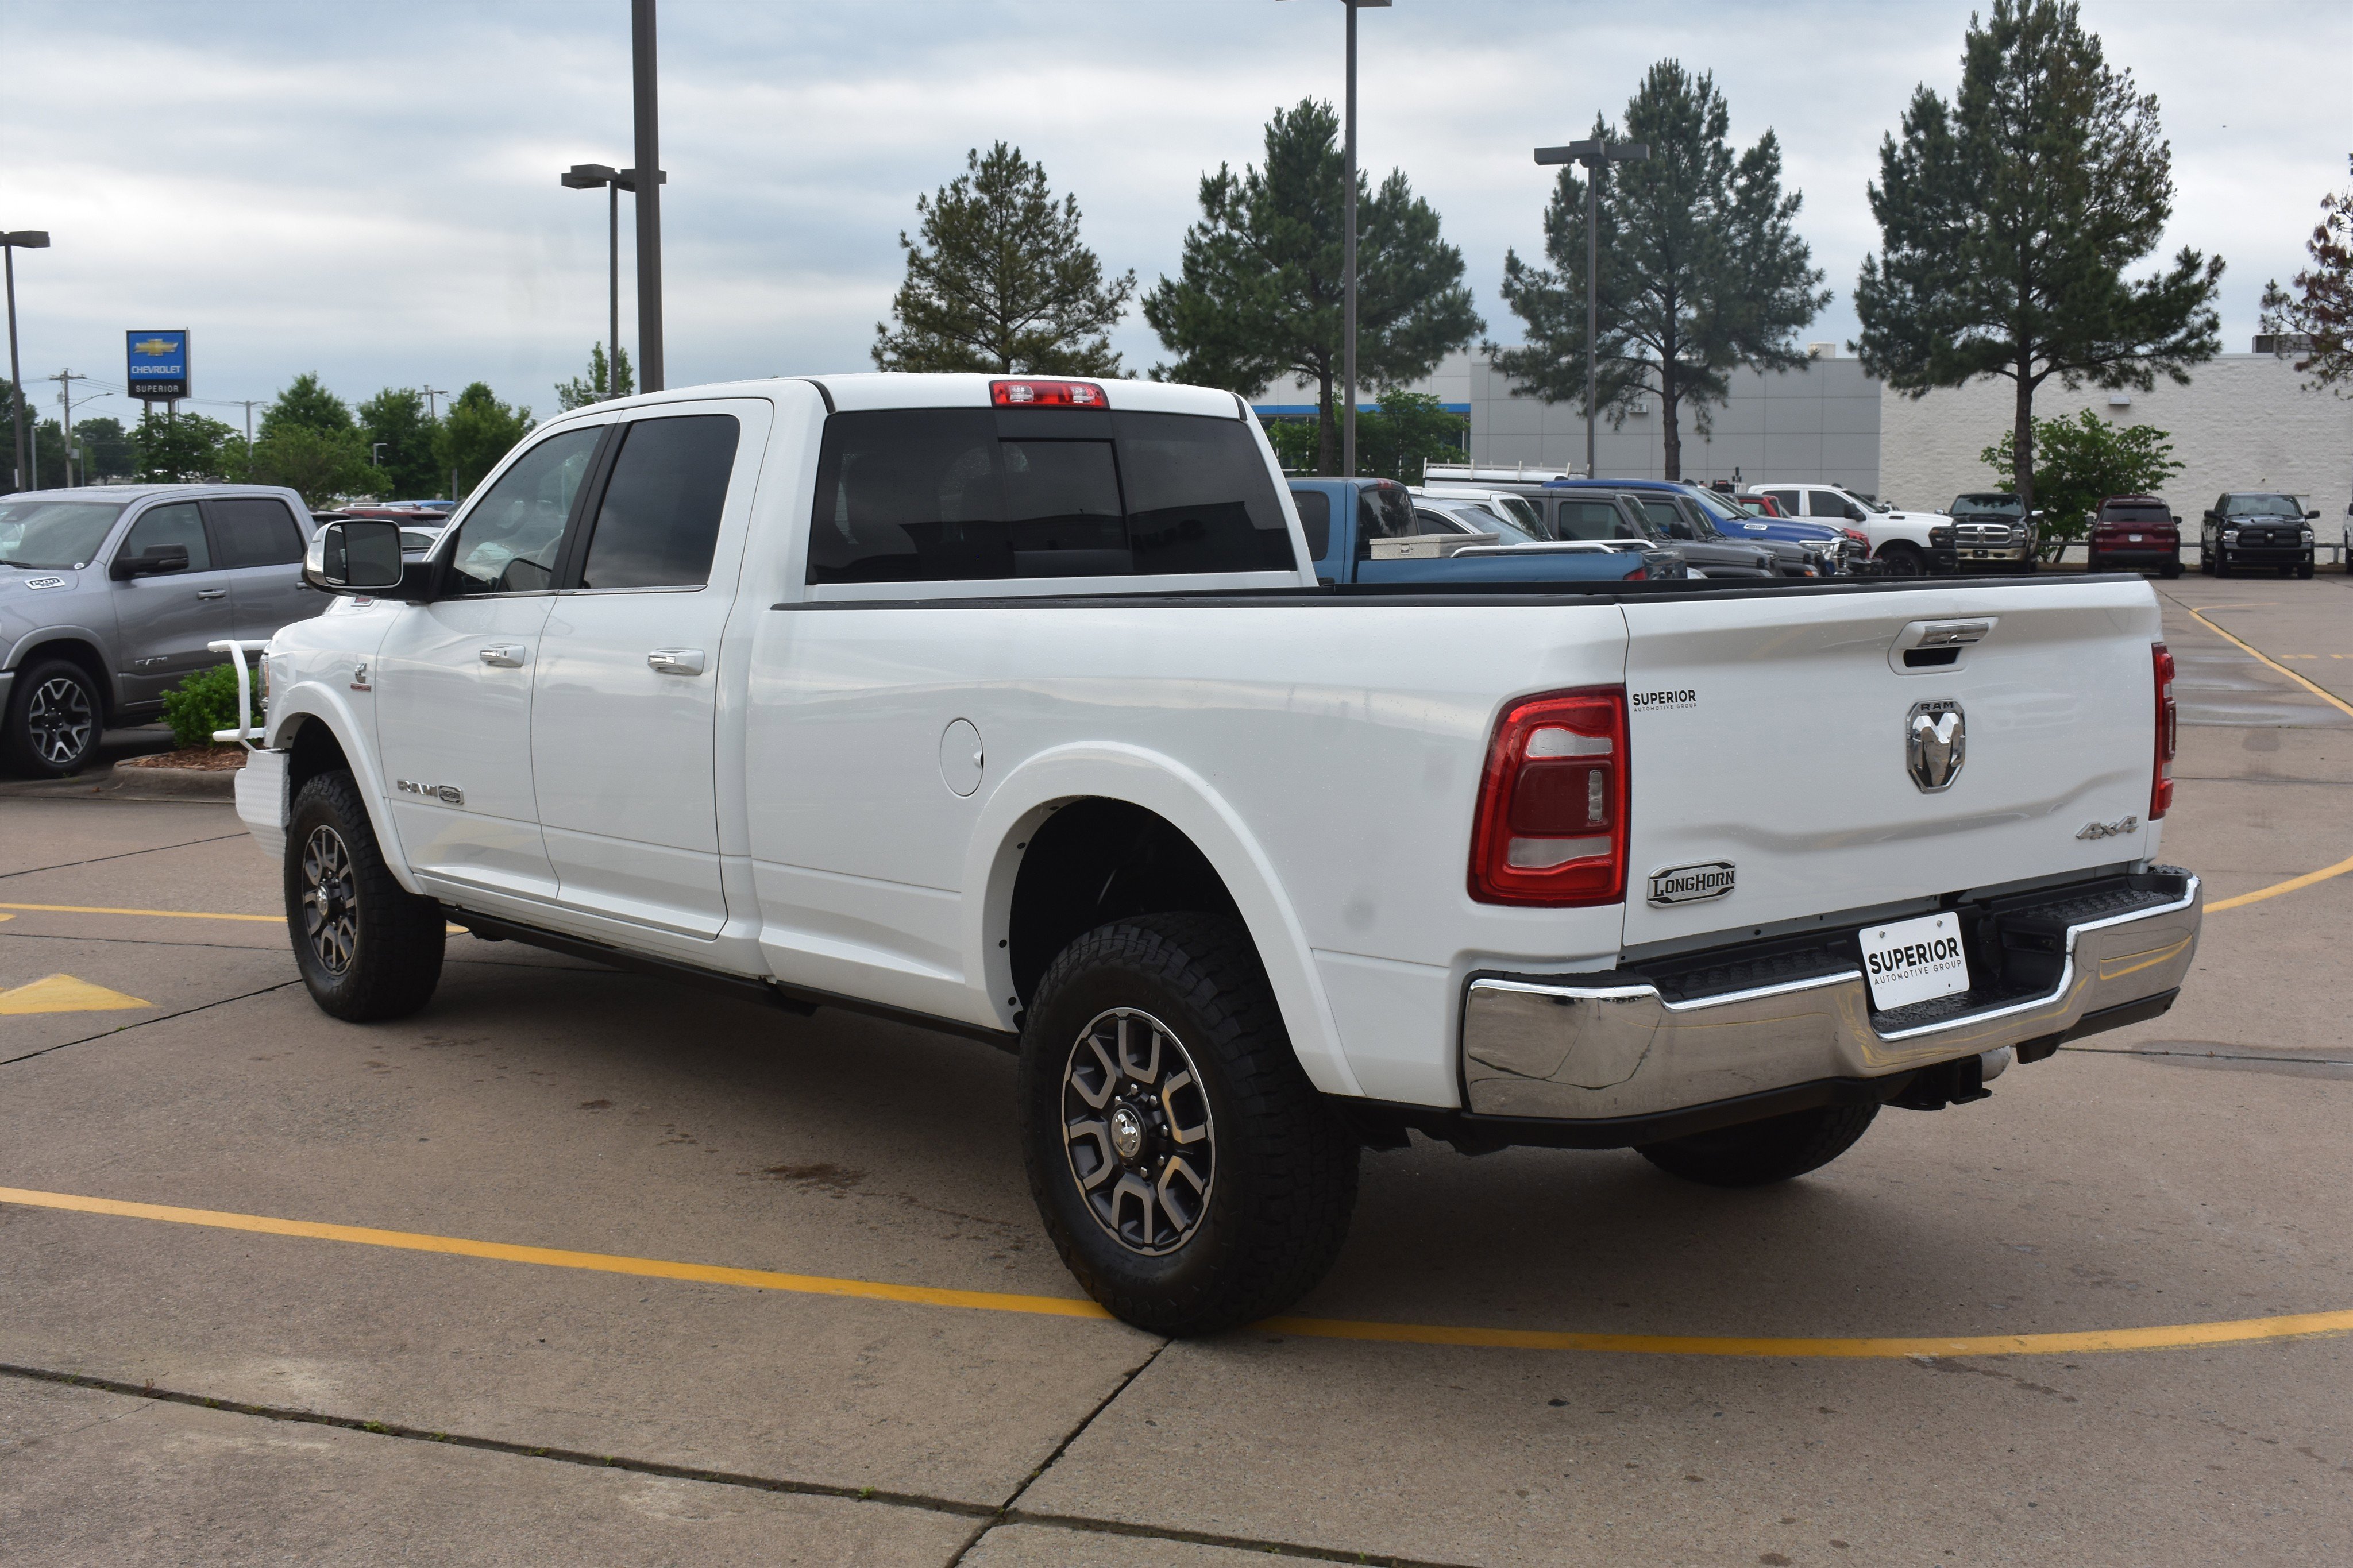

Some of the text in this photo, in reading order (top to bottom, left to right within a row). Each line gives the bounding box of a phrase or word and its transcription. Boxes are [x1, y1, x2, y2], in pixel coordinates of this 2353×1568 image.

[132, 365, 181, 374] CHEVROLET
[1633, 689, 1696, 706] SUPERIOR
[1920, 701, 1953, 711] RAM
[1634, 704, 1674, 712] AUTOMOTIVE
[397, 779, 438, 797] RAM
[1868, 937, 1960, 975] SUPERIOR
[1874, 959, 1961, 986] AUTOMOTIVE GROUP
